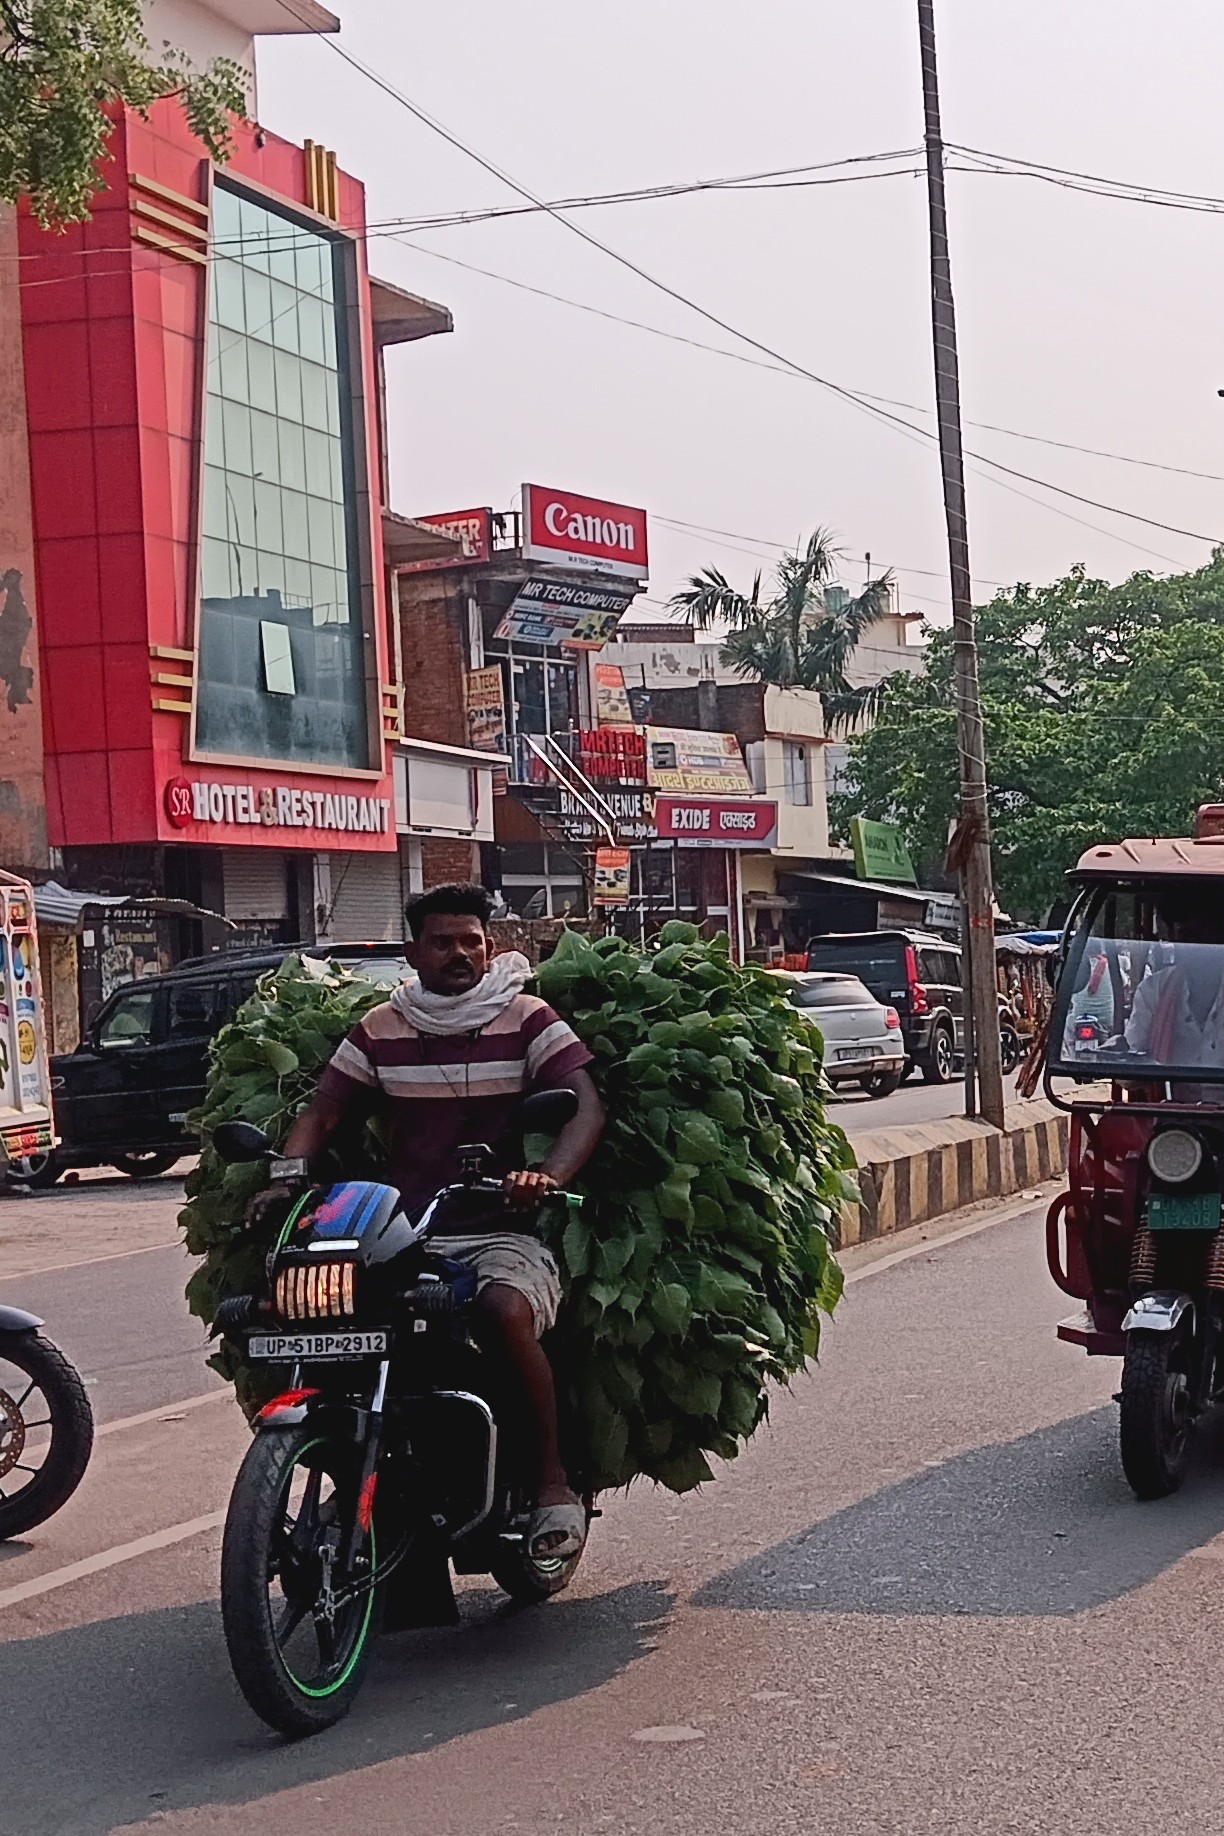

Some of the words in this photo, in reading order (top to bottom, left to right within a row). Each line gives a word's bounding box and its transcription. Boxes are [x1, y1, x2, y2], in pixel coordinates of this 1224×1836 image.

[545, 503, 635, 550] Canon
[522, 582, 543, 597] MR
[543, 584, 576, 602] TECH
[574, 592, 630, 610] COMPUTER
[171, 787, 191, 816] SR
[191, 782, 261, 823] HOTEL
[260, 787, 278, 826] &
[276, 786, 391, 832] RESTAURANT
[671, 808, 711, 830] EXIDE
